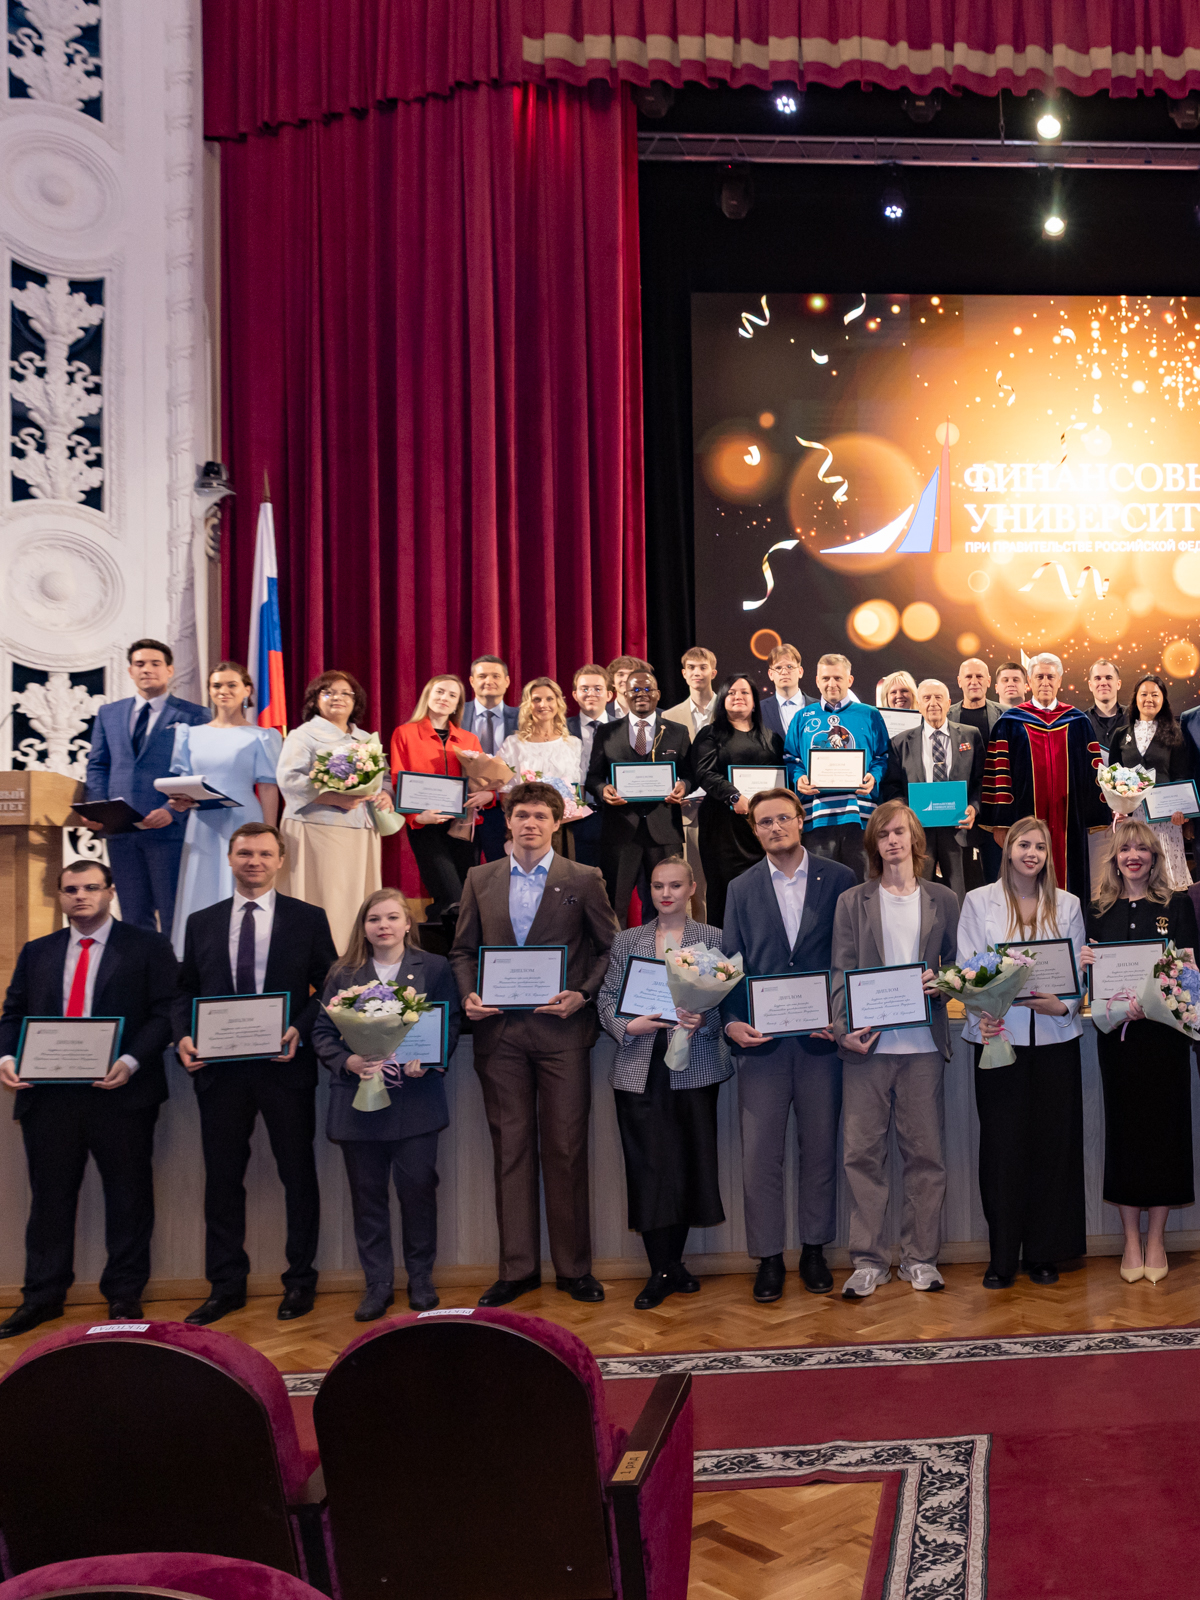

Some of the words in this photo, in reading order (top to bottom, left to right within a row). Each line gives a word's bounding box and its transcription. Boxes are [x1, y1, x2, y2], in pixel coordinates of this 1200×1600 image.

[965, 541, 990, 553] ПРИ
[993, 541, 1092, 553] ПРАВИТЕЛЬСТВЕ
[1095, 538, 1175, 552] РОССИЙСКОЙ
[625, 1456, 640, 1469] ряд
